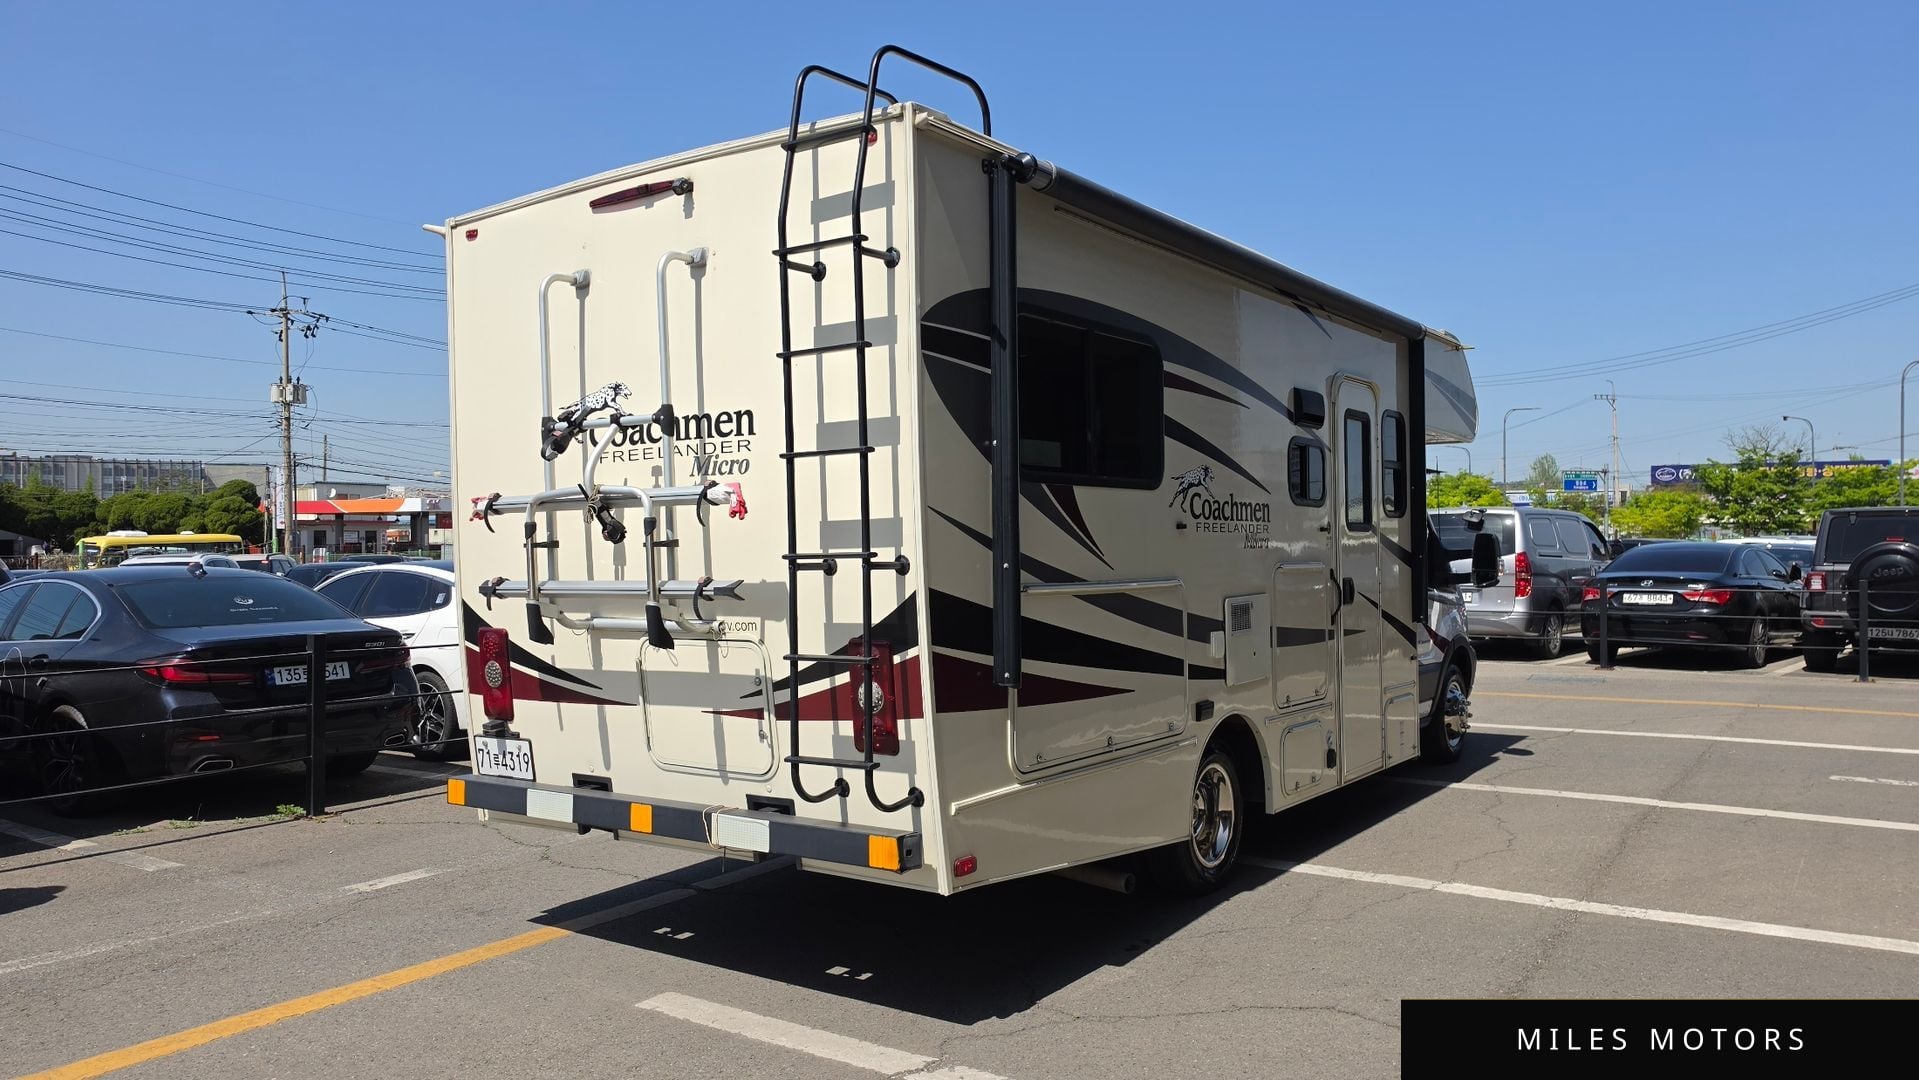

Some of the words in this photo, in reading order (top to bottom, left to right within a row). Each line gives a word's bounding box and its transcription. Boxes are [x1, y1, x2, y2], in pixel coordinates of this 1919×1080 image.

[598, 438, 752, 464] FREELANDER
[689, 453, 750, 477] Micro
[1189, 492, 1271, 523] Coachmen
[1195, 522, 1270, 534] FREELANDER
[1873, 566, 1905, 578] Jeep
